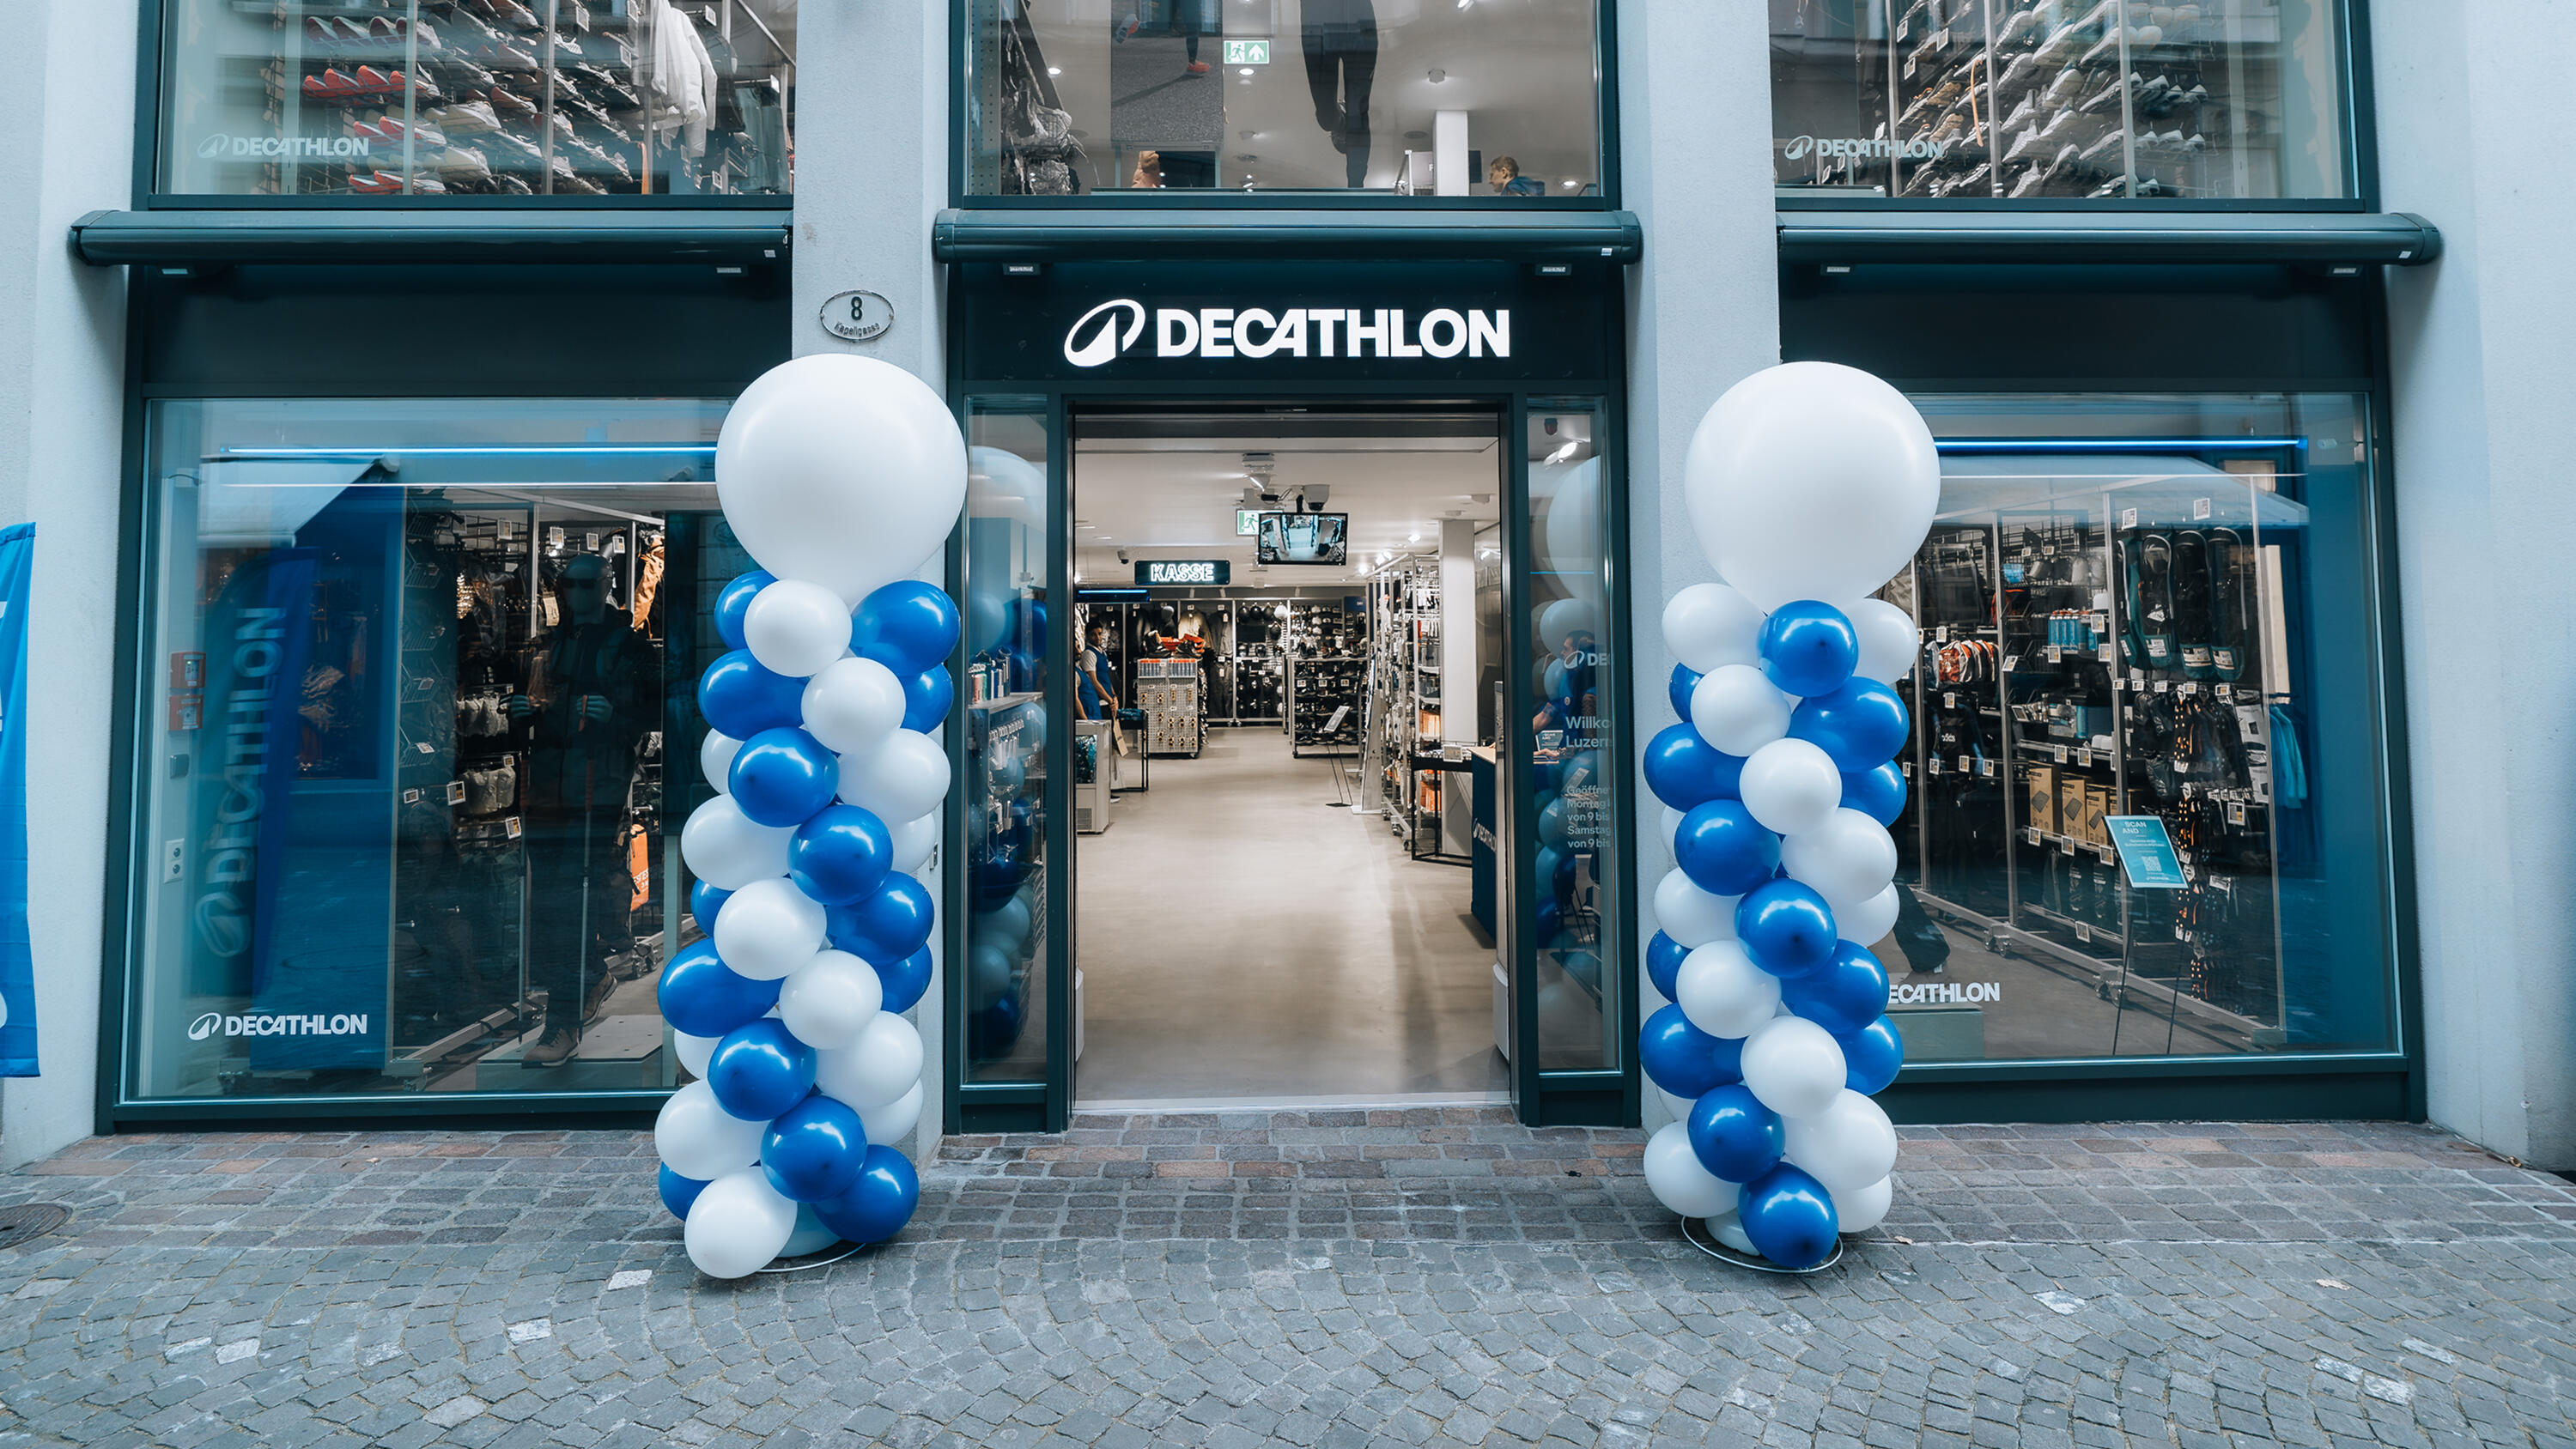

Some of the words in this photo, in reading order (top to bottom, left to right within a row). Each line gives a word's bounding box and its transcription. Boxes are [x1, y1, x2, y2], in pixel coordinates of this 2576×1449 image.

[233, 137, 369, 156] DECATHLON
[1817, 138, 1944, 158] DECATHLON
[851, 296, 862, 320] 8
[1157, 308, 1510, 358] DECATHLON
[1150, 563, 1214, 582] KASSE
[1565, 716, 1610, 729] Willko
[1567, 785, 1608, 795] Geöffne
[1587, 811, 1595, 822] 9
[1567, 825, 1611, 836] Samstag
[1588, 838, 1595, 848] 9
[1888, 982, 2000, 1003] ECATHLON
[225, 1015, 368, 1036] DECATHLON
